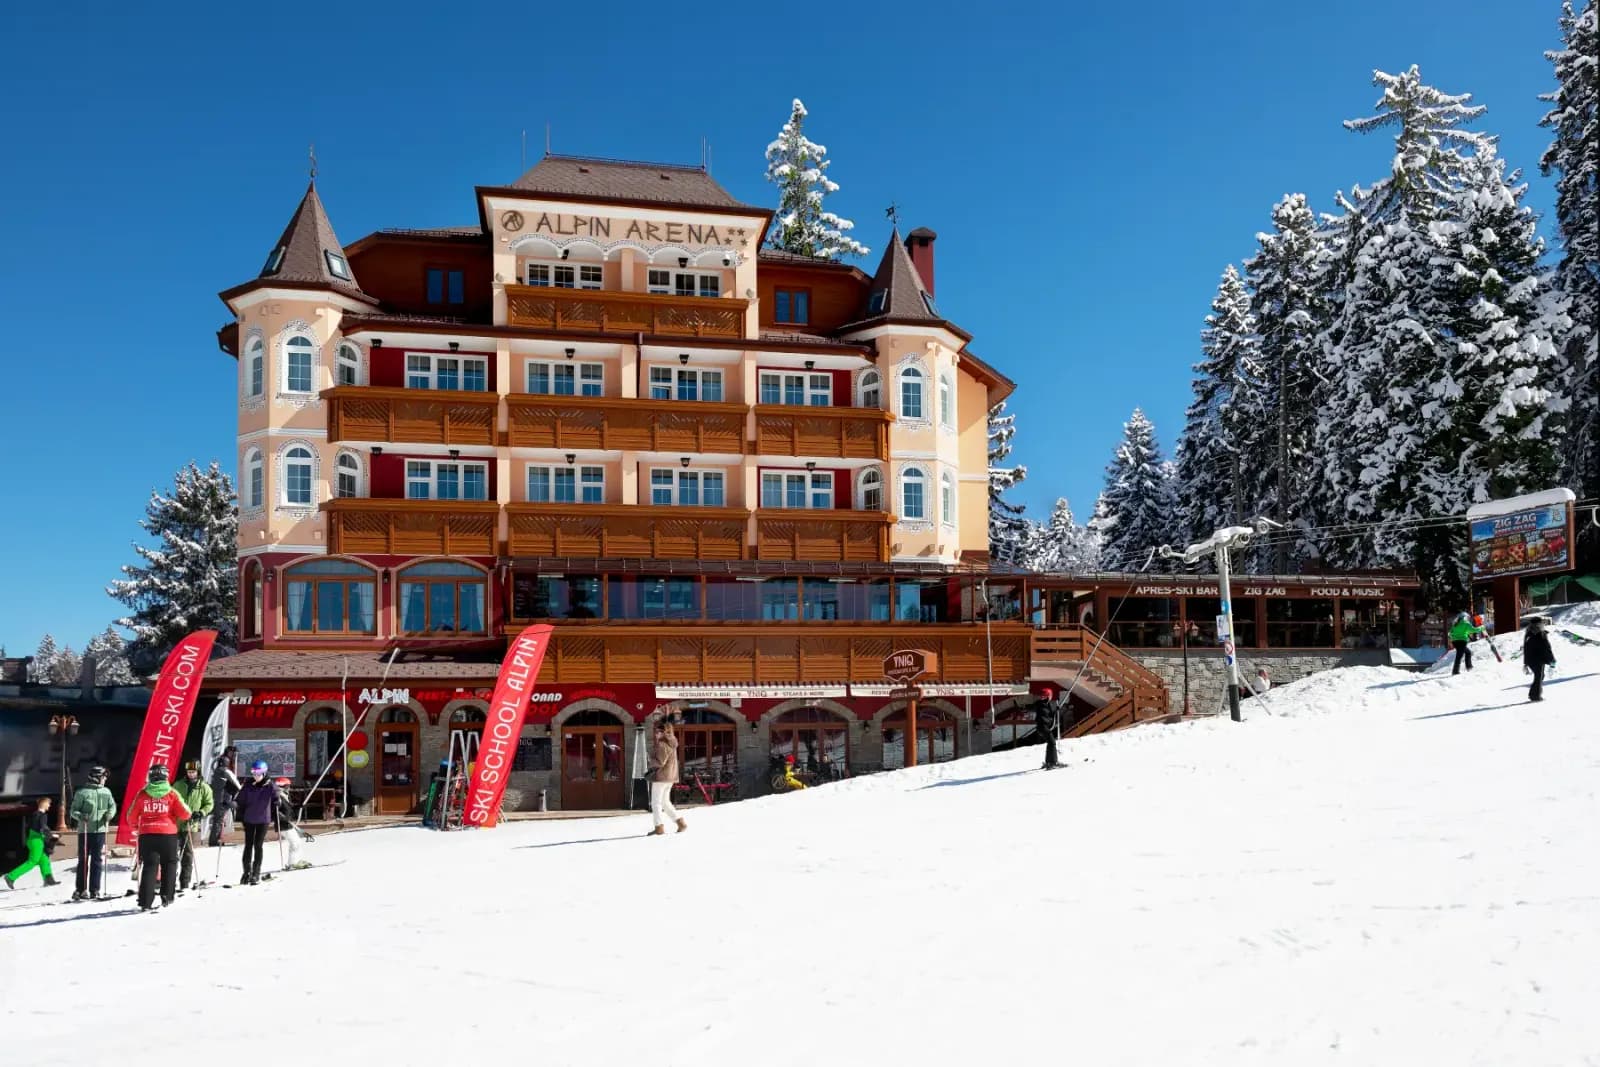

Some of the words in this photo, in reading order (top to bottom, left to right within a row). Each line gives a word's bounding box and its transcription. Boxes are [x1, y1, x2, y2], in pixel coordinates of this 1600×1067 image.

[536, 212, 611, 238] ALPIN
[626, 219, 721, 246] ARENA
[1494, 517, 1512, 529] ZIG
[1514, 512, 1537, 525] ZAG
[1135, 586, 1194, 595] APRES-SKI
[1196, 586, 1218, 595] BAR
[1244, 587, 1262, 595] ZIG
[1265, 587, 1286, 595] ZAG
[1311, 588, 1340, 596] FOOD
[1352, 588, 1385, 596] MUSIC
[507, 637, 538, 692] ALPIN
[893, 654, 914, 668] YNIQ
[358, 687, 409, 704] ALPIN
[530, 692, 563, 703] OARD
[747, 689, 768, 698] YNIQ
[935, 688, 955, 697] YNIQ
[231, 696, 253, 705] SKI
[480, 697, 521, 784] SCHOOL
[143, 803, 169, 814] ALPIN
[470, 789, 495, 823] SKI
